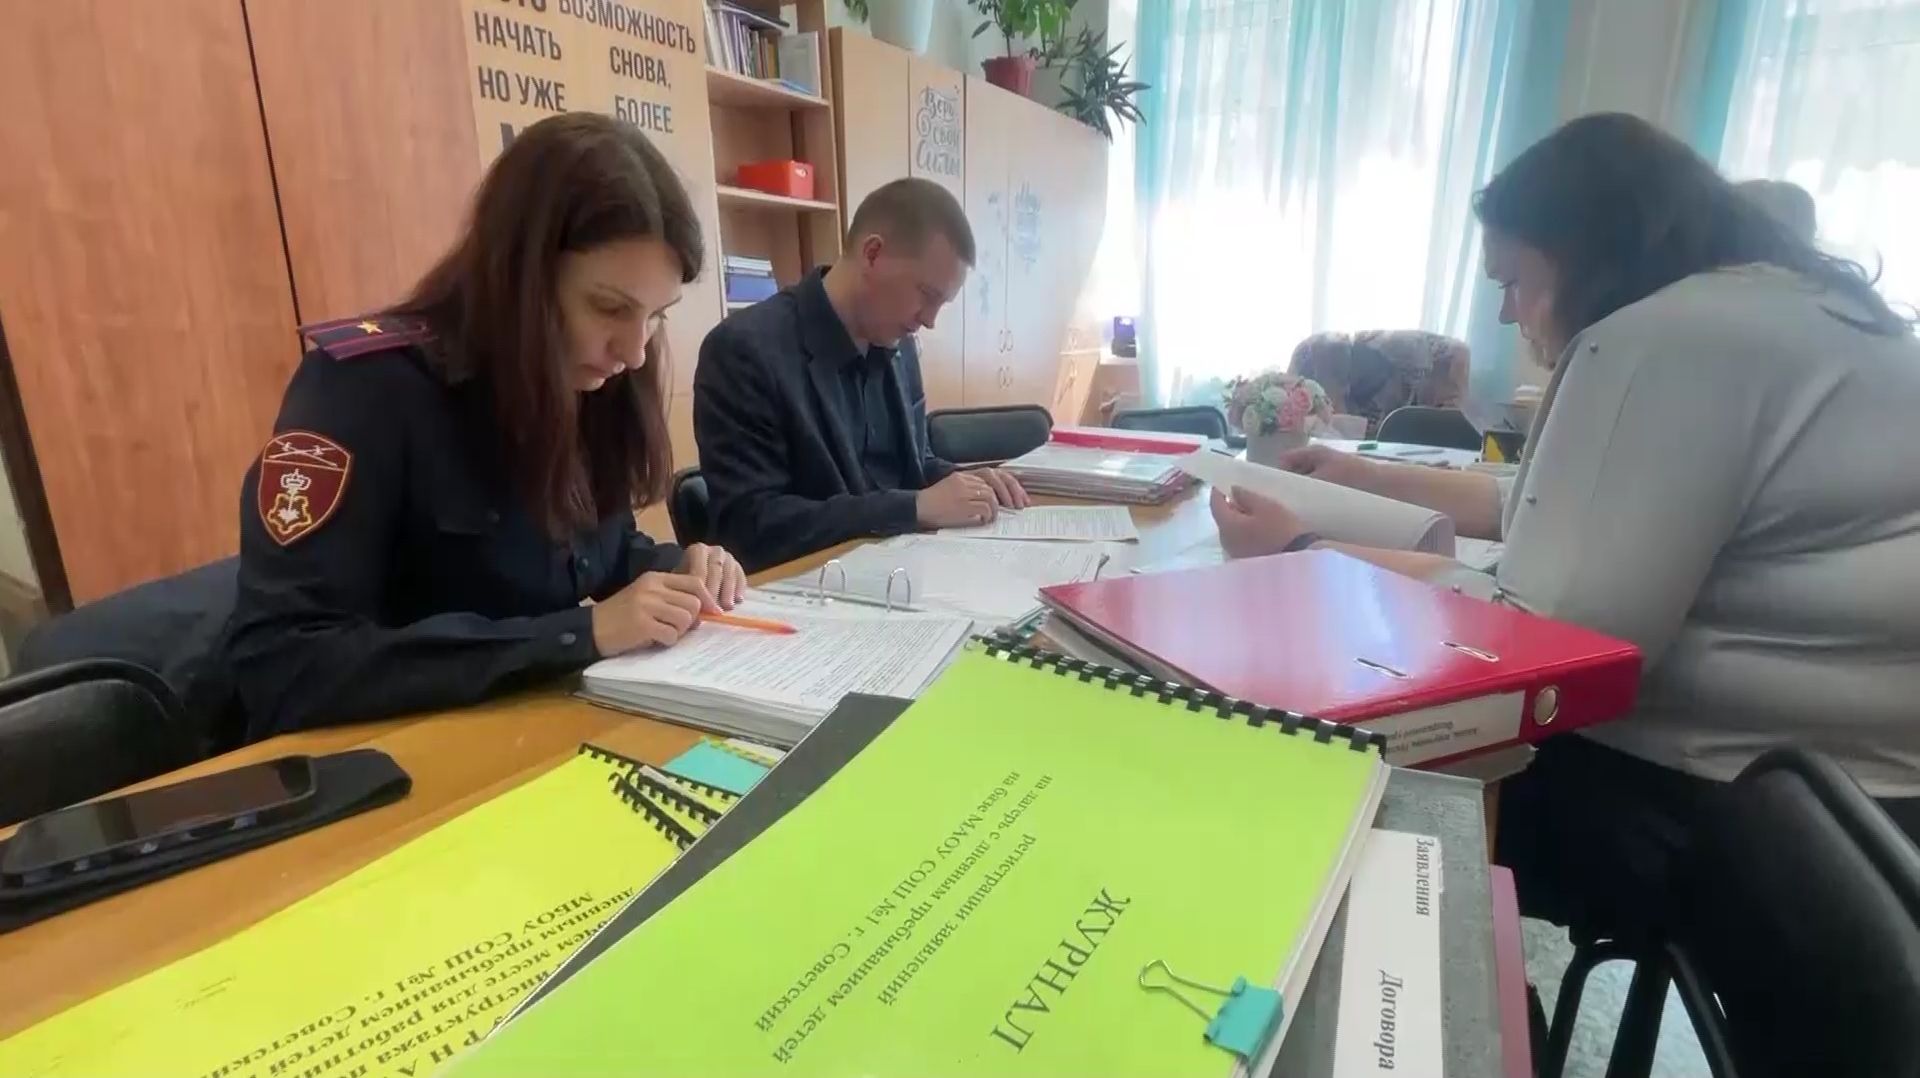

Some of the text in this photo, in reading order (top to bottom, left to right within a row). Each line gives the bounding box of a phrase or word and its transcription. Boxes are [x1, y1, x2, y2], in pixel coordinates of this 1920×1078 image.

[474, 12, 562, 60] НАЧАТЬ
[478, 66, 673, 133] НО УЖЕ БОЛЕЕ
[977, 787, 1008, 813] базе
[1002, 771, 1020, 787] на
[936, 814, 983, 859] МАОУ
[892, 860, 936, 899] СОШ
[1415, 837, 1436, 917] Заявления
[523, 891, 594, 935] МБОУ
[772, 775, 1053, 1064] на лагерь с дневным пребыванием детей
[865, 898, 897, 925] №1
[877, 834, 1036, 1006] регистрации заявлений
[269, 886, 635, 1077] дневным пребыванием детей
[445, 932, 513, 970] СОШ
[484, 949, 551, 987] месте
[990, 888, 1131, 1054] ЖУРНАЛ
[376, 969, 550, 1064] инструктажа
[431, 983, 478, 1014] для
[755, 942, 850, 1032] Советский
[1373, 969, 1404, 1071] Договора
[200, 1005, 357, 1078] Советски
[293, 1009, 423, 1078] работни
